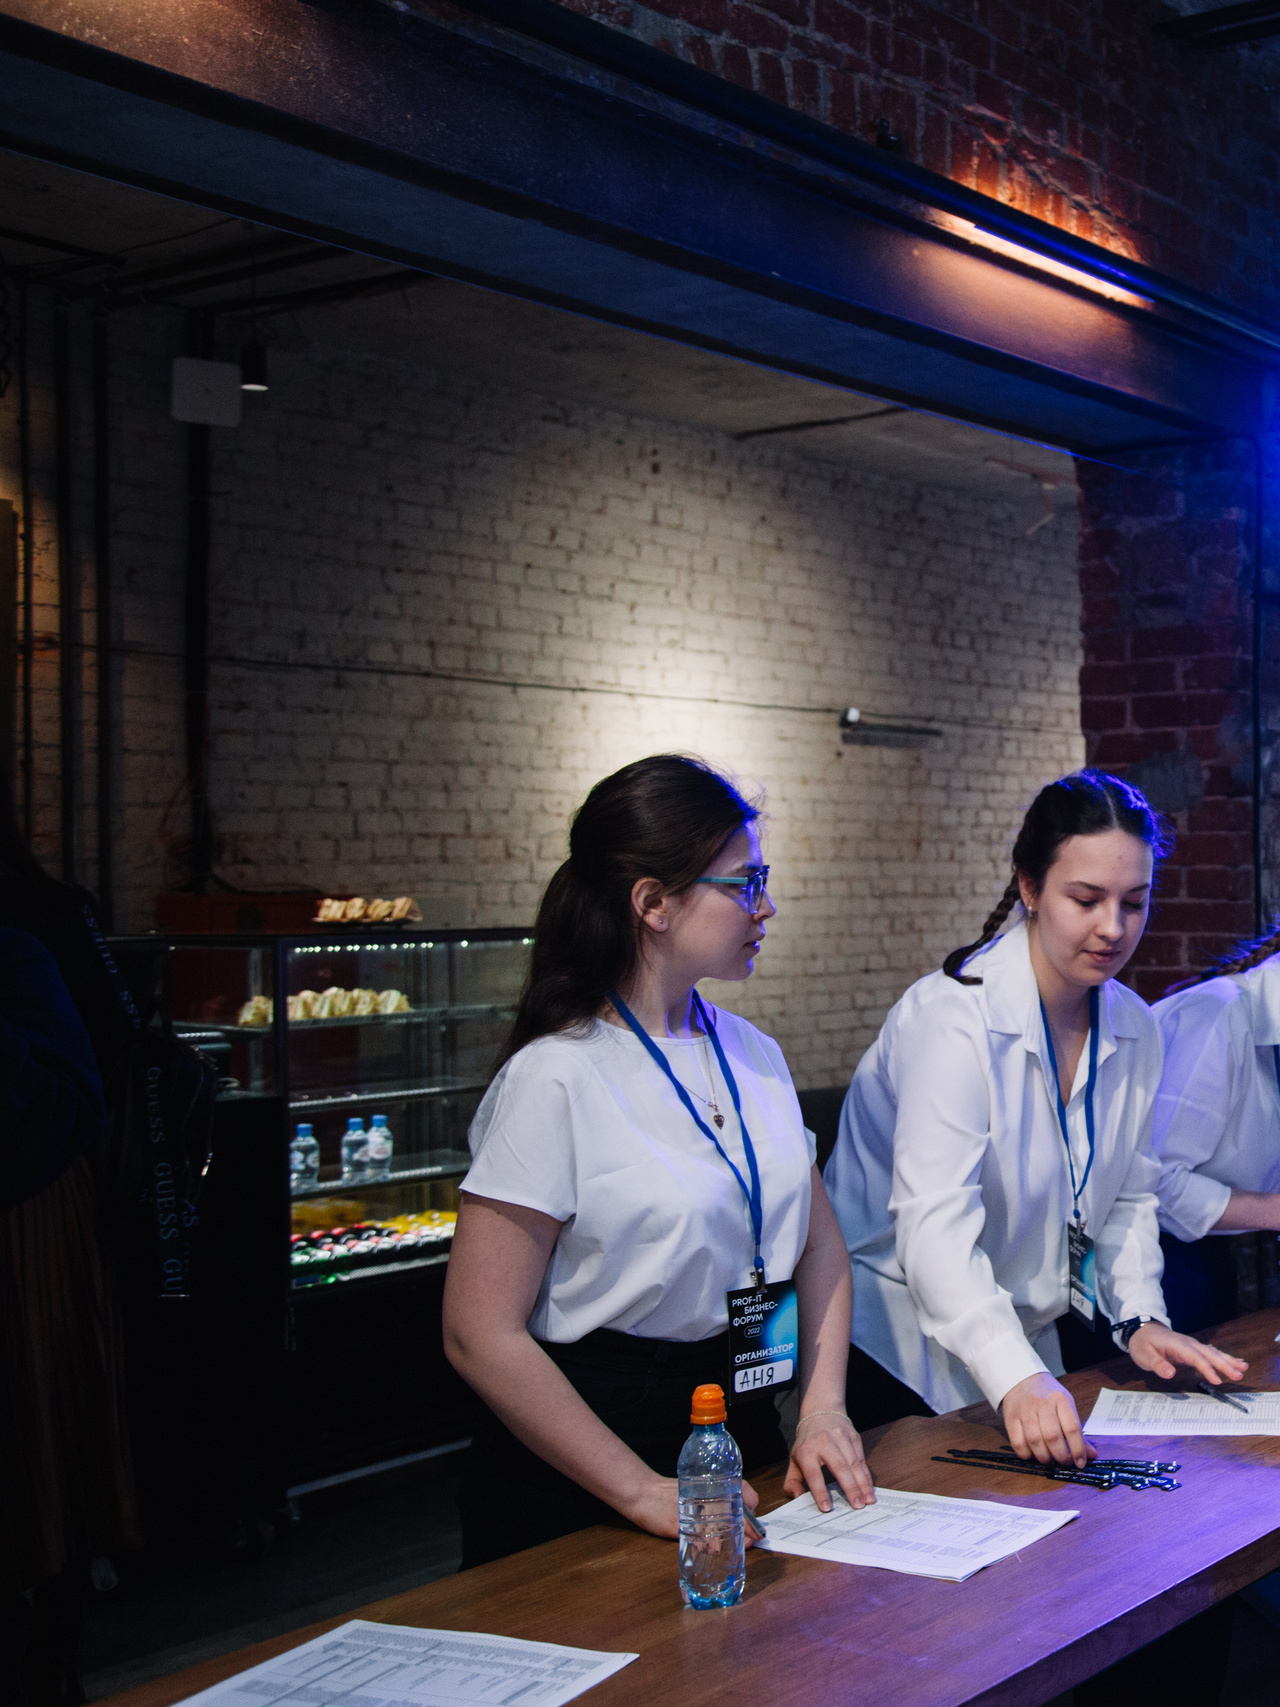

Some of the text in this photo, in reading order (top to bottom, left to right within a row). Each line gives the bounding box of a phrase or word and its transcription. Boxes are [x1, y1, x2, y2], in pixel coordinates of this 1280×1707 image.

[147, 1066, 166, 1144] GUESS
[153, 1161, 180, 1241] GUESS
[731, 1294, 762, 1308] PROF-IT
[744, 1301, 778, 1315] БИЗНЕС-
[732, 1313, 764, 1327] ФОРУМ
[747, 1326, 761, 1335] 2022
[734, 1342, 794, 1364] ОРГАНИЗАТОР
[739, 1366, 775, 1389] АНЯ
